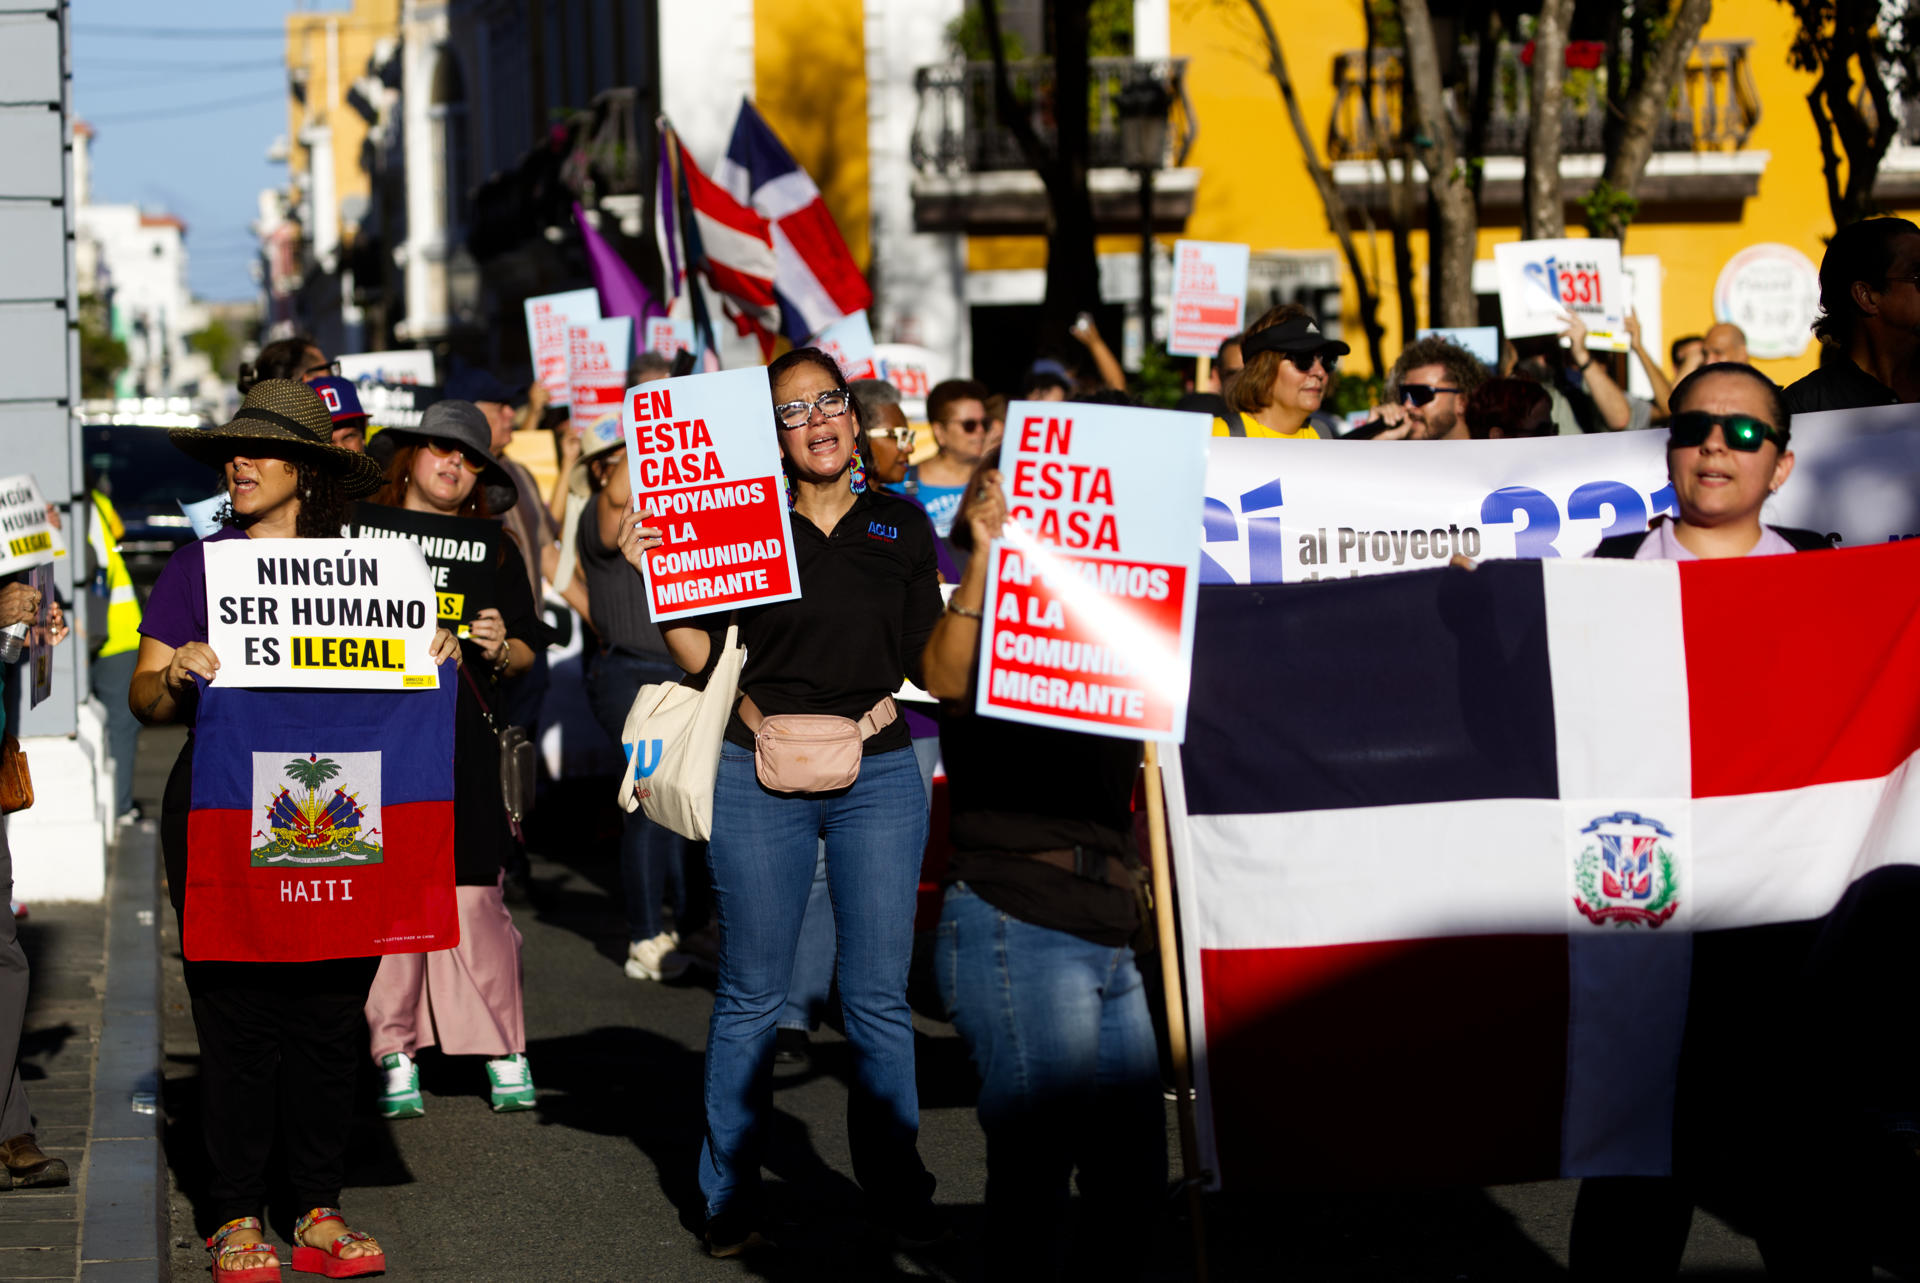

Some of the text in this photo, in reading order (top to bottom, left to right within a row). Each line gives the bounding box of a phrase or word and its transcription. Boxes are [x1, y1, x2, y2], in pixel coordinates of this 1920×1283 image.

[1559, 271, 1602, 305] 331
[633, 389, 673, 422] EN
[636, 418, 714, 455] ESTA
[1019, 416, 1073, 455] EN
[640, 451, 725, 488] CASA
[1013, 460, 1115, 506] ESTA
[645, 483, 766, 517] APOYAMOS
[669, 521, 698, 544] LA
[868, 521, 898, 539] ACLU
[1009, 505, 1119, 552] CASA
[1299, 528, 1328, 565] al
[1338, 523, 1480, 566] Proyecto
[1480, 480, 1682, 560] 33
[257, 549, 378, 586] NINGÚN
[652, 538, 782, 576] COMUNIDAD
[656, 569, 769, 606] MIGRANTE
[219, 596, 279, 625] SER
[291, 598, 426, 629] HUMANO
[997, 592, 1065, 629] A LA
[245, 637, 404, 669] ES ILEGAL.
[992, 668, 1144, 719] MIGRANTE
[280, 879, 353, 902] HAITI
